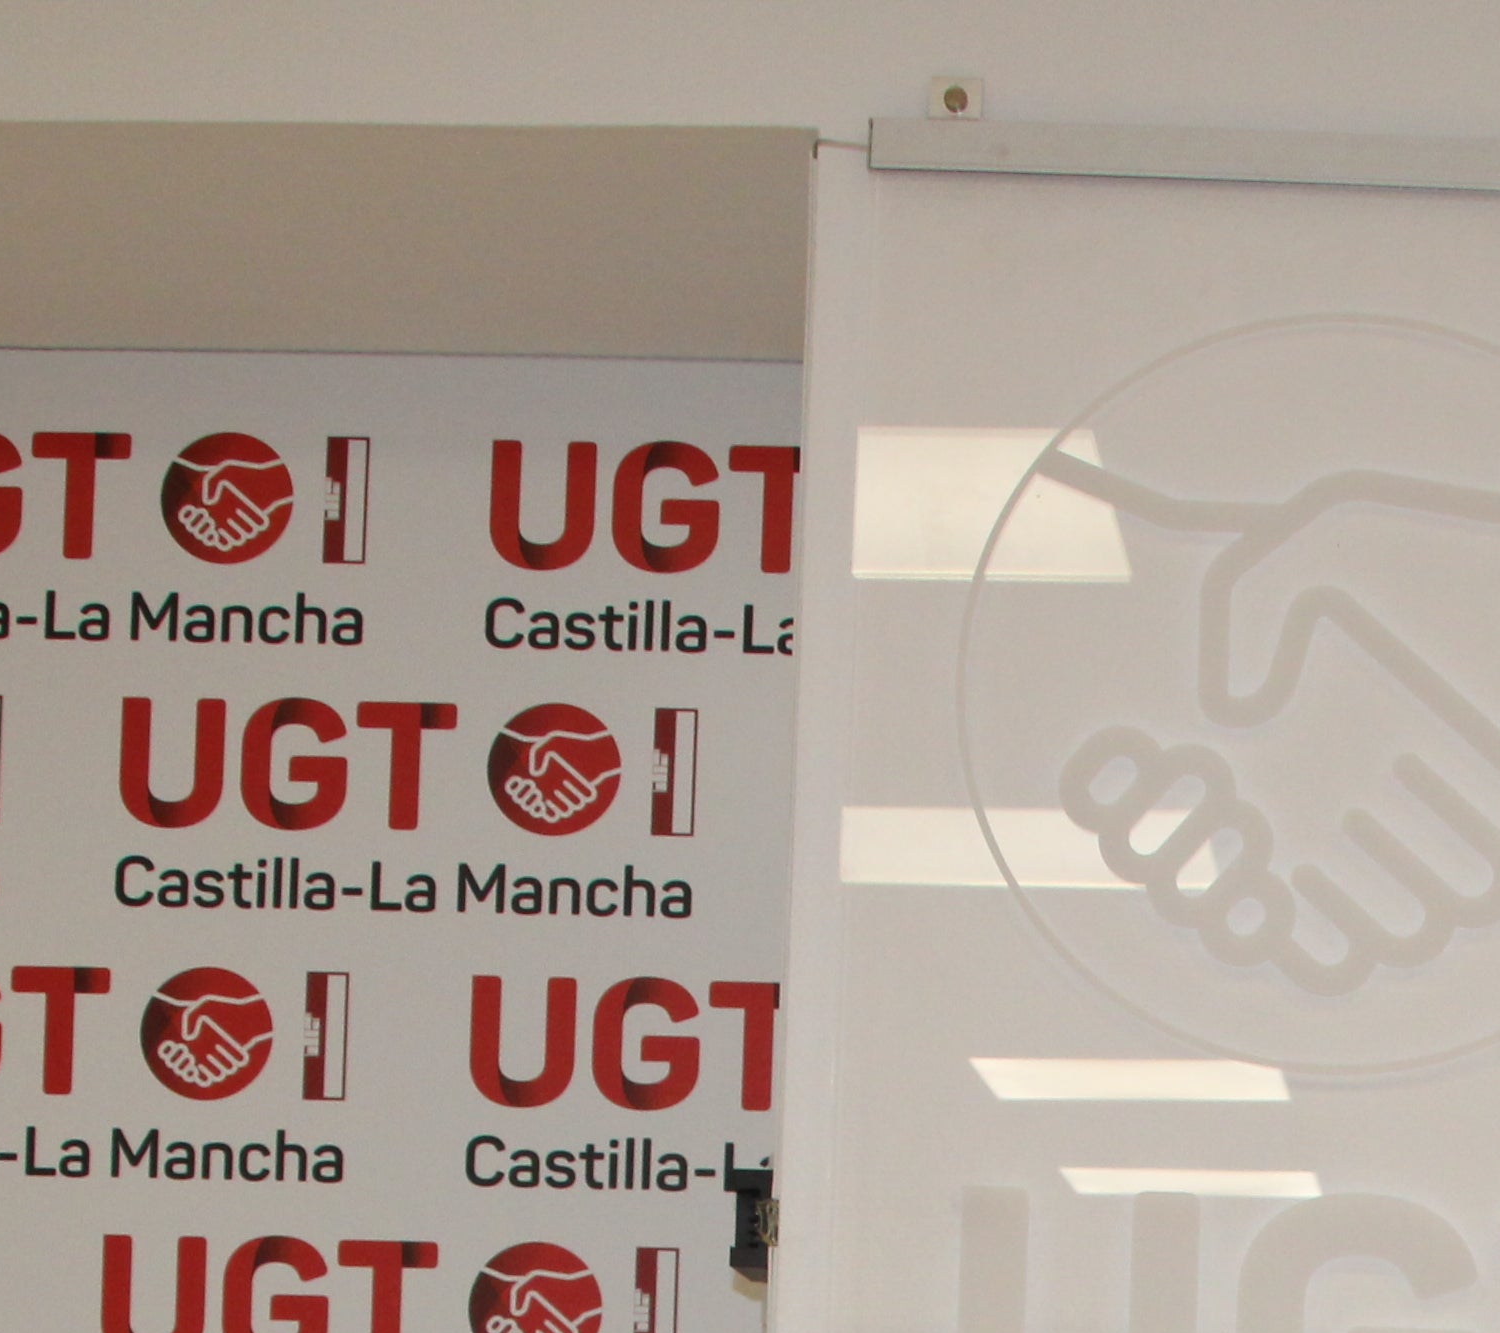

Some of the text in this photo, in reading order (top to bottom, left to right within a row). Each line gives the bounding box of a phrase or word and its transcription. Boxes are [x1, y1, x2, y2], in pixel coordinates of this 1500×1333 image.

[490, 440, 801, 574] UGT
[131, 592, 363, 646] Mancha
[120, 697, 458, 831] UGT
[115, 856, 692, 919] Castilla-La Mancha
[470, 975, 780, 1111] UGT
[111, 1128, 344, 1183] Mancha
[466, 1136, 769, 1192] Castilla-L
